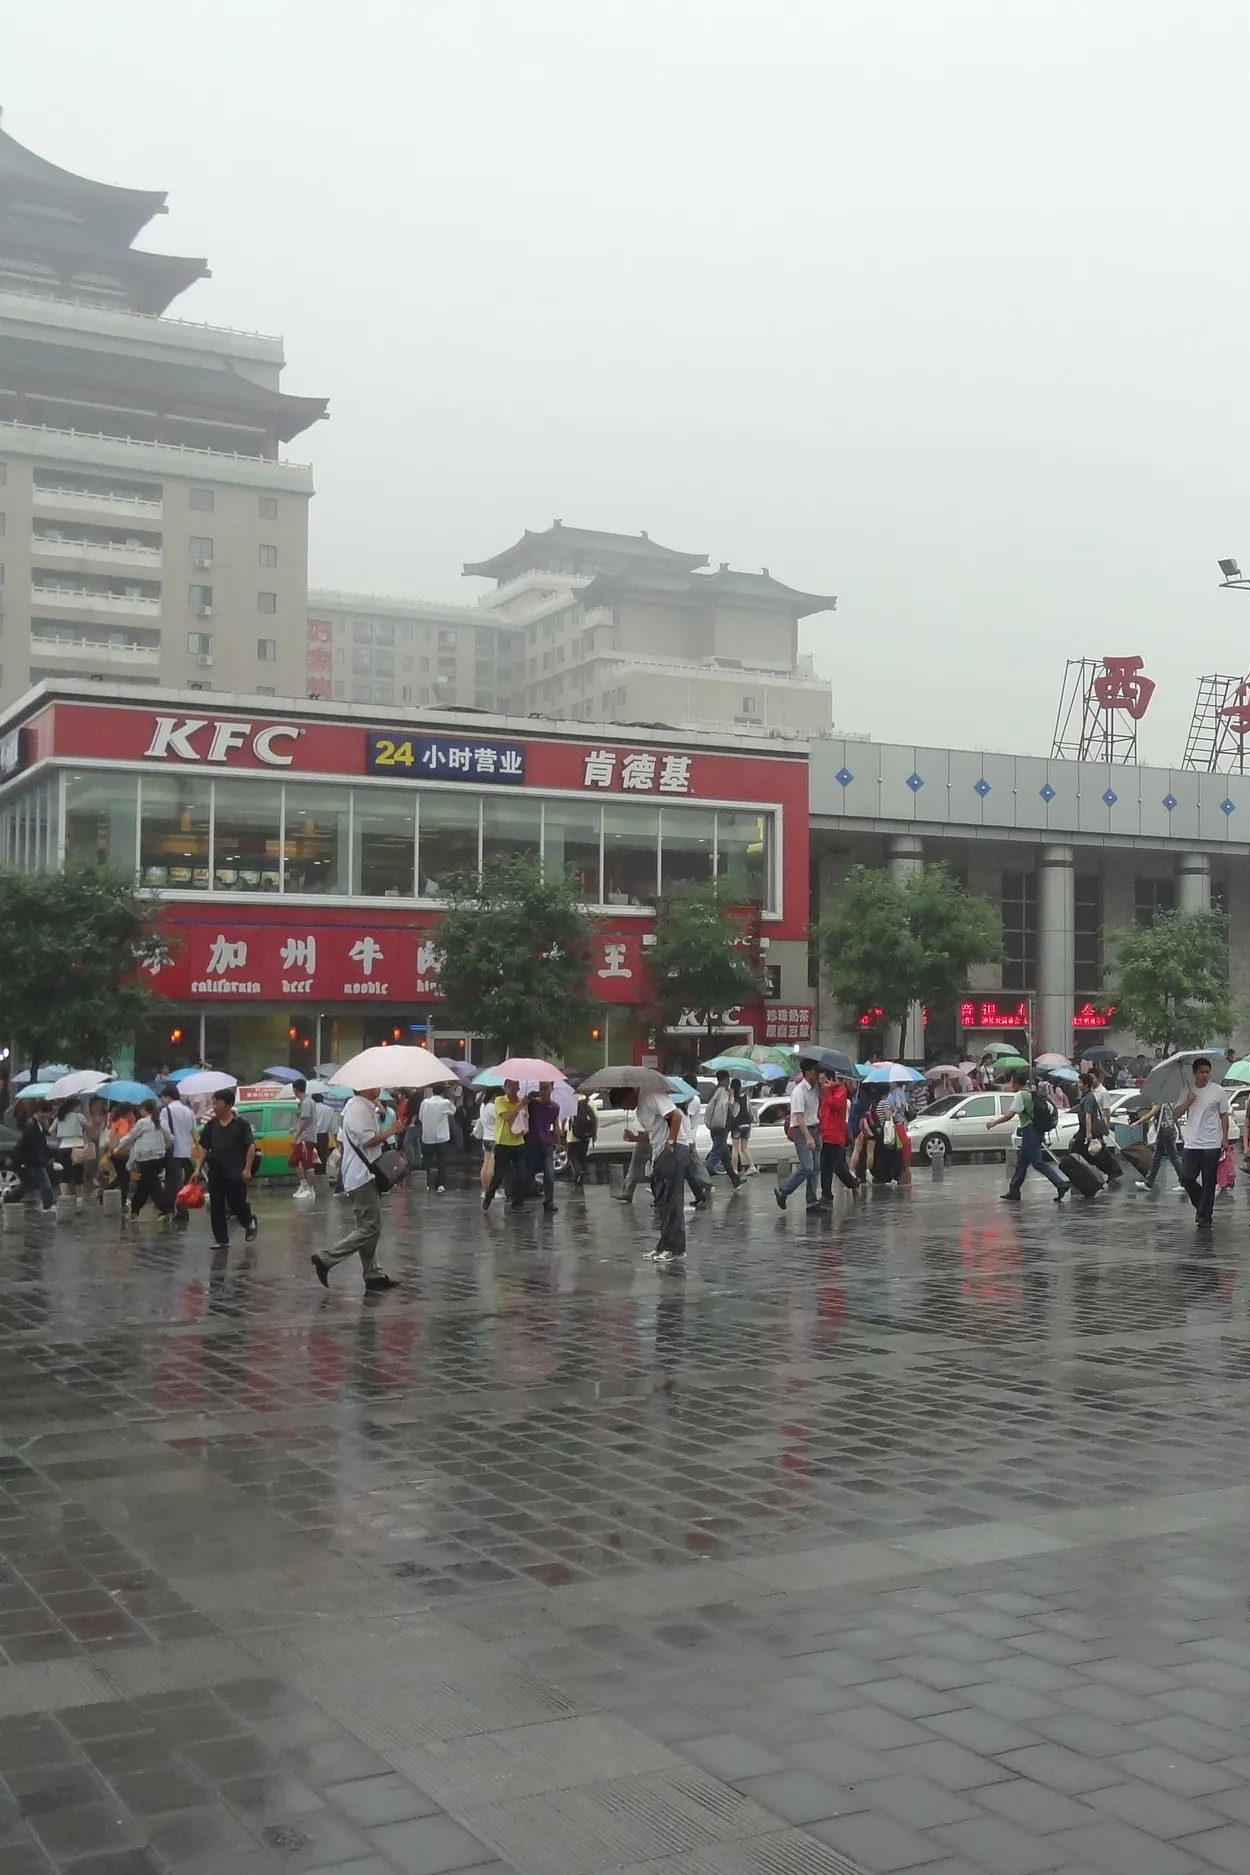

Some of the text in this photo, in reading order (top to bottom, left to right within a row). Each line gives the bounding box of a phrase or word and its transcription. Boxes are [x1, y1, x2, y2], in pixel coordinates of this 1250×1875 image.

[144, 717, 300, 765] KFC
[583, 751, 692, 793] 肯德基
